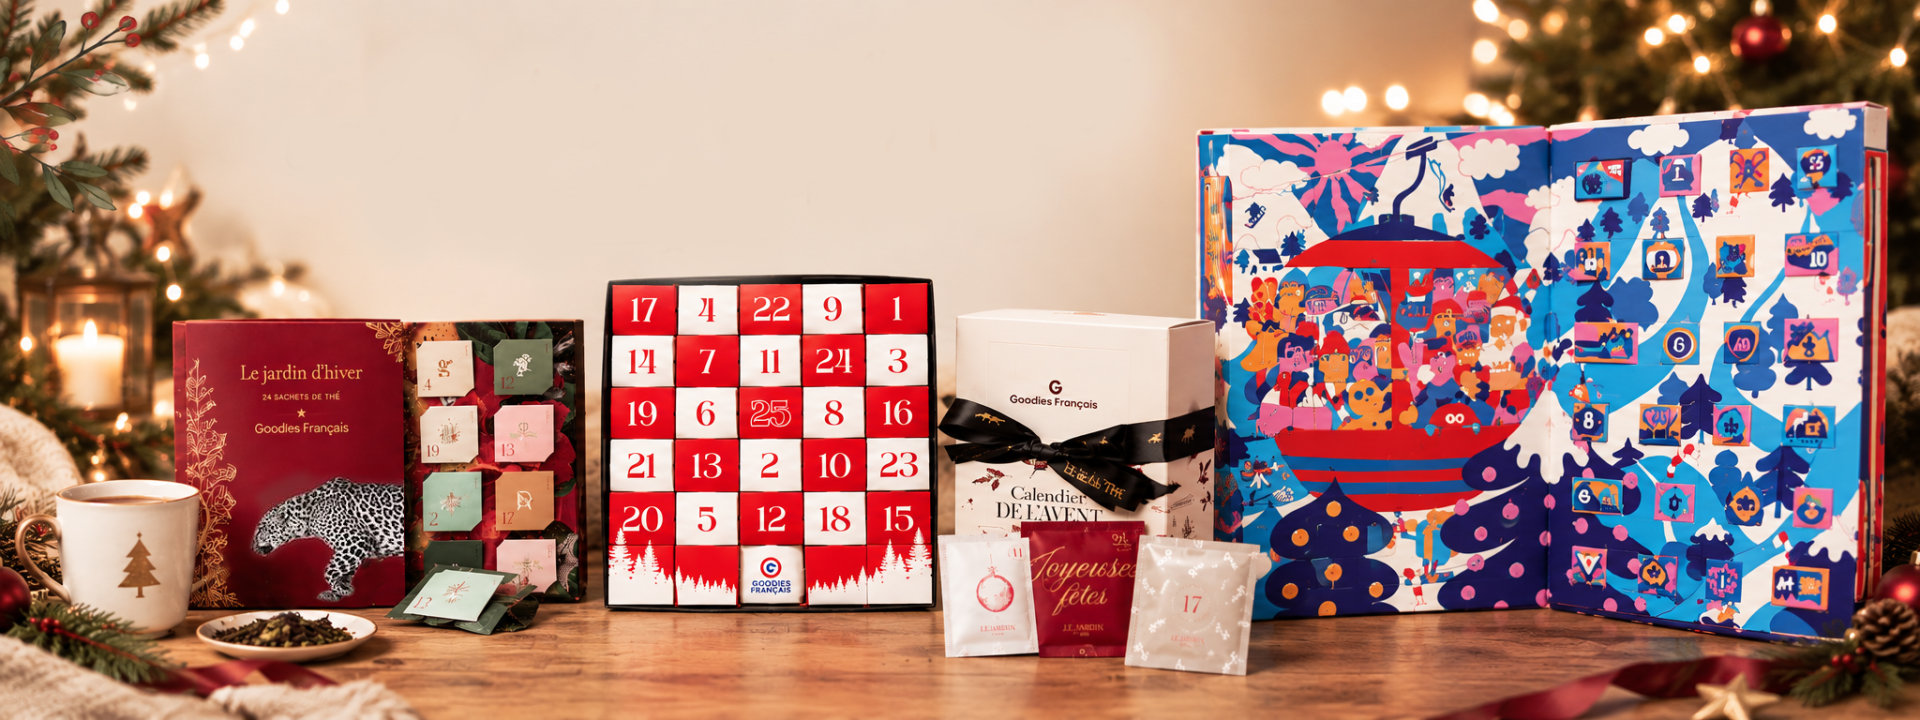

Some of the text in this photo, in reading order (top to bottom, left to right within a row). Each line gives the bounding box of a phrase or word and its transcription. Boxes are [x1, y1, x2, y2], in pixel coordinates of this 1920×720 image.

[1809, 250, 1828, 268] 10
[630, 297, 658, 323] 17
[698, 297, 716, 322] 4
[753, 296, 791, 322] 22
[823, 296, 843, 322] 9
[892, 296, 902, 321] 1
[628, 348, 657, 374] 14
[699, 348, 716, 374] 7
[760, 349, 781, 374] 11
[815, 348, 853, 374] 24
[888, 348, 909, 374] 3
[240, 363, 363, 386] Le jardin d'hiver
[500, 376, 514, 390] 12
[1048, 379, 1063, 395] G
[262, 390, 341, 401] 24 SACHETS DE THÉ
[1009, 394, 1099, 411] Goodies Français
[627, 400, 658, 427] 19
[696, 400, 716, 427] 6
[750, 399, 792, 428] 25
[824, 399, 845, 426] 8
[883, 399, 913, 426] 16
[1583, 411, 1594, 429] 8
[302, 421, 350, 436] Français
[426, 444, 440, 457] 19
[501, 442, 515, 457] 13
[627, 452, 656, 479] 21
[692, 452, 722, 479] 13
[760, 452, 779, 479] 2
[819, 452, 852, 479] 10
[880, 451, 919, 478] 23
[1010, 485, 1088, 505] Calendier
[621, 505, 664, 533] 20
[697, 506, 717, 532] 5
[757, 505, 787, 532] 12
[820, 505, 851, 532] 18
[883, 505, 915, 532] 15
[996, 501, 1022, 520] DE
[750, 586, 791, 595] FRANÇAIS
[751, 579, 791, 587] GOODIES
[1183, 595, 1202, 614] 17
